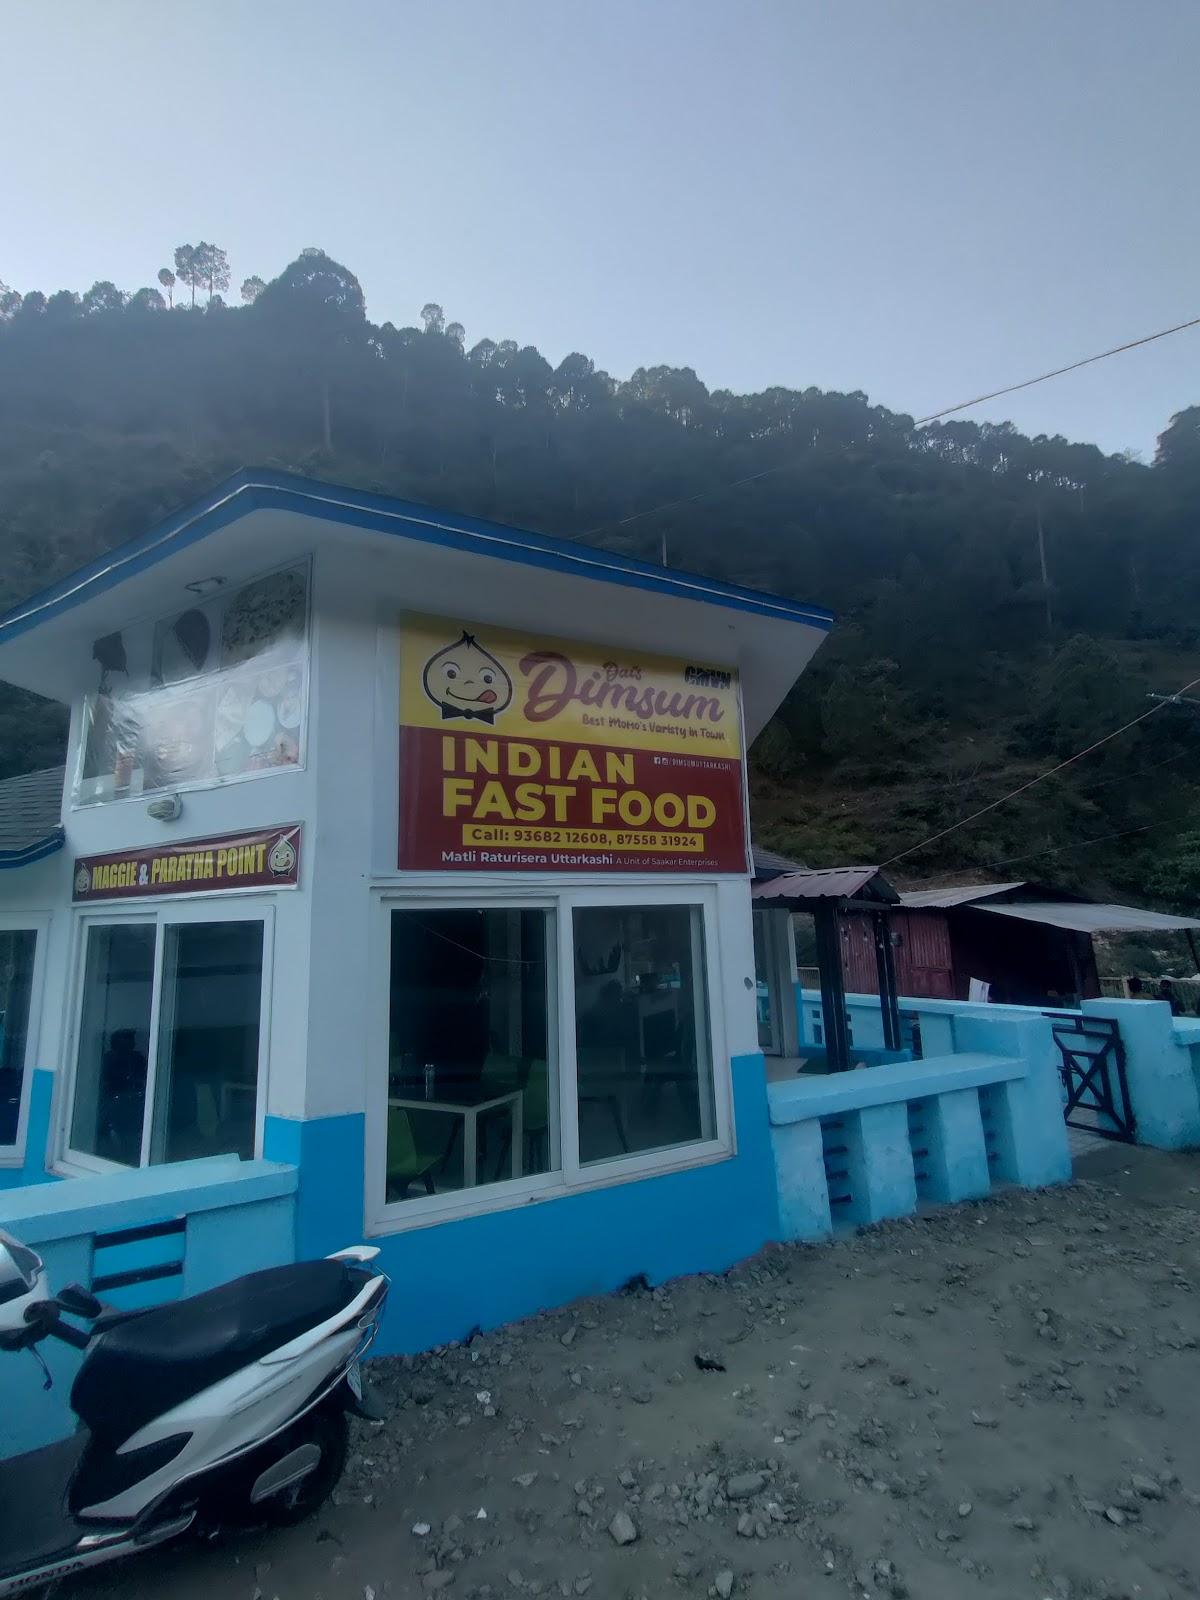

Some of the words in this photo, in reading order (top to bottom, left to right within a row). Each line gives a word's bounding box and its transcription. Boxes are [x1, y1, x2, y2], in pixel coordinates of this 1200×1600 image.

[519, 651, 725, 722] Dimsum
[582, 713, 604, 727] Best
[700, 728, 725, 741] Town
[442, 736, 635, 785] INDIAN
[442, 777, 577, 822] FAST
[591, 788, 717, 829] FOOD
[472, 828, 509, 841] Call:
[514, 830, 561, 843] 93682
[565, 832, 612, 846] 12608,
[616, 834, 657, 846] 87558
[661, 835, 697, 847] 31924
[91, 861, 138, 890] MAGGIE
[138, 863, 149, 886] &
[151, 851, 214, 884] PARATHA
[216, 843, 267, 878] POINT
[441, 851, 476, 862] Matli
[480, 852, 547, 864] Raturisera
[551, 853, 613, 865] Uttarkashi
[615, 857, 623, 865] A
[624, 857, 640, 865] Unit
[642, 857, 651, 865] of
[651, 858, 677, 866] Saakar
[678, 858, 718, 867] Enterprises
[9, 1561, 85, 1588] HONDA
